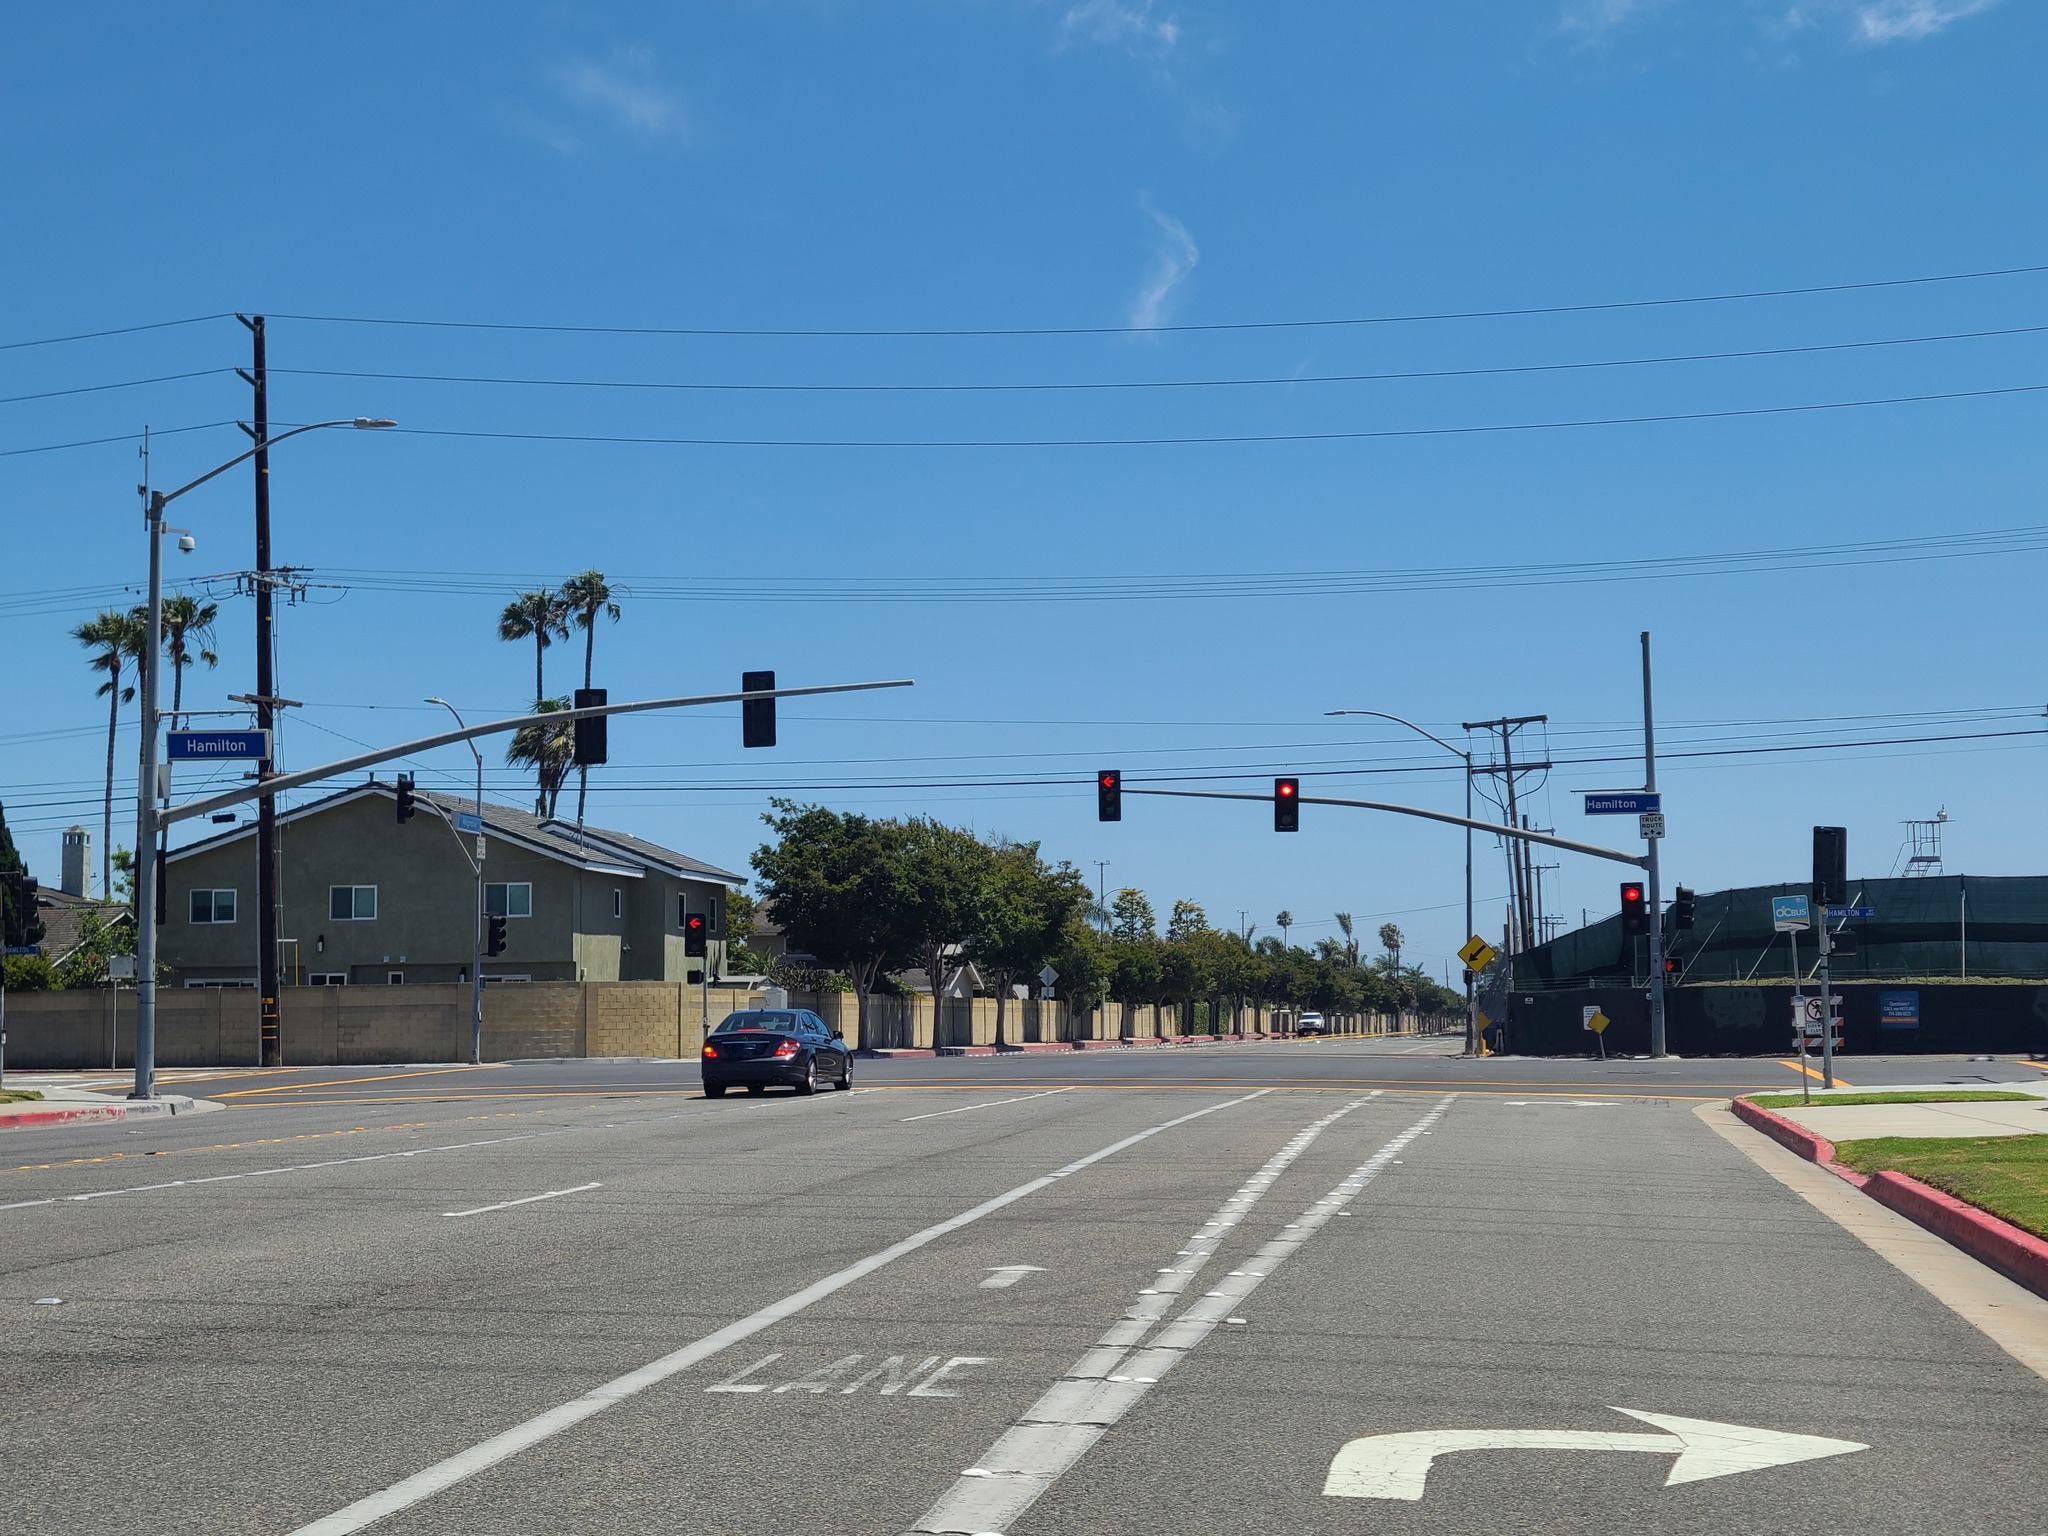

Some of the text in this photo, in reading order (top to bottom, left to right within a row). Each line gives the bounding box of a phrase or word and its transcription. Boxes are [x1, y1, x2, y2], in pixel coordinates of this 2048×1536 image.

[187, 739, 247, 752] Hamilton
[1587, 799, 1637, 809] Hamilton
[1828, 909, 1860, 917] HAMILTON
[703, 1353, 992, 1397] LANE
